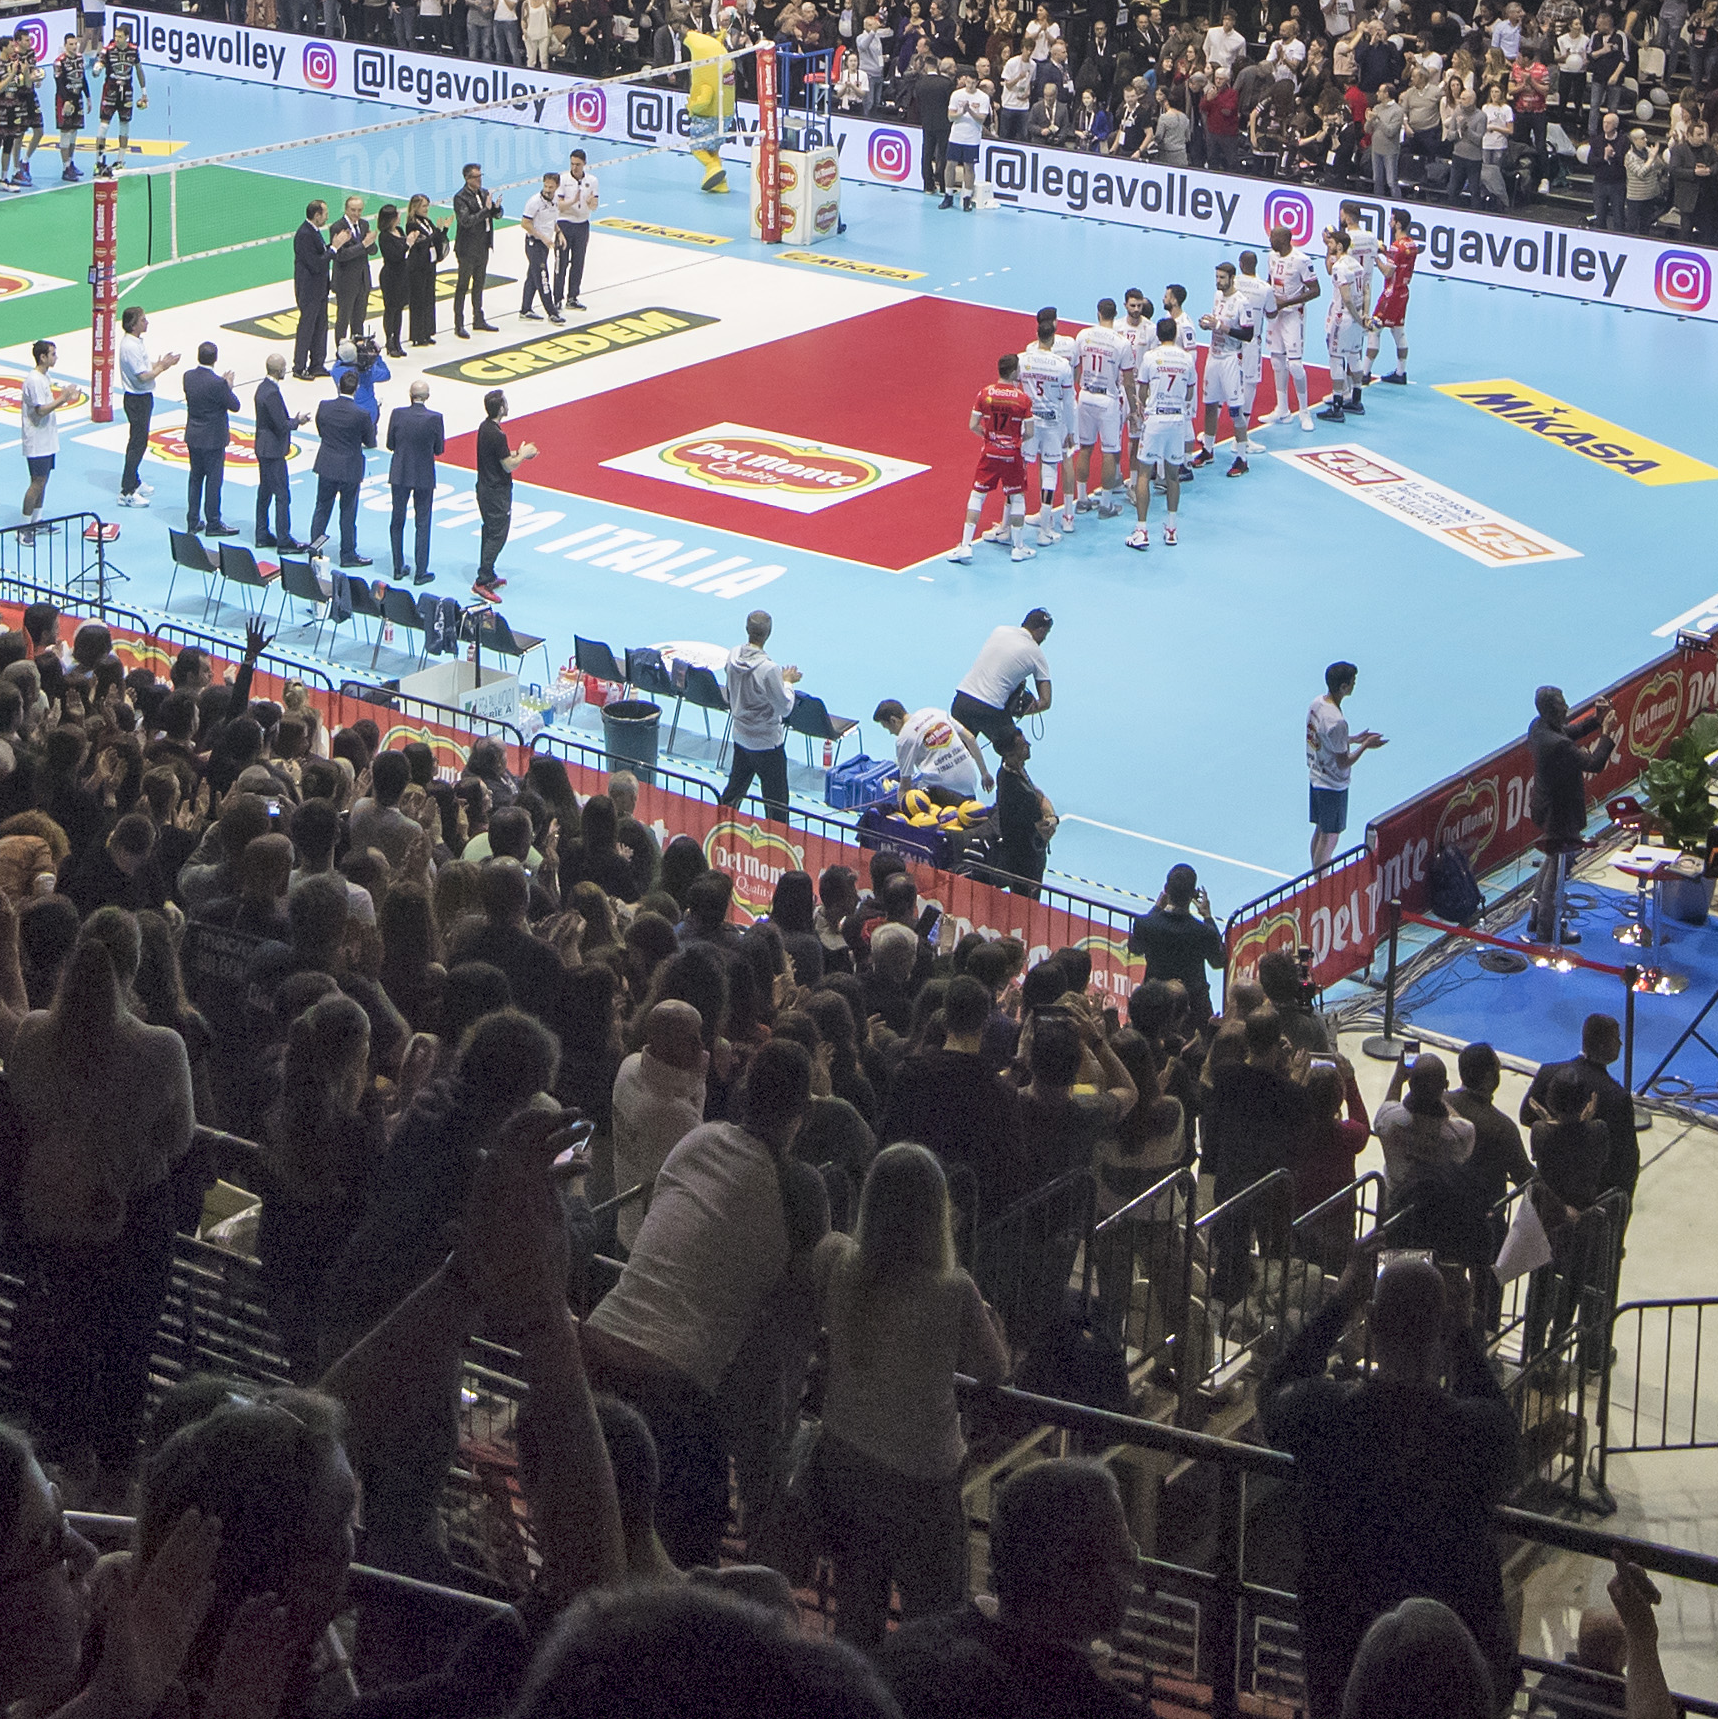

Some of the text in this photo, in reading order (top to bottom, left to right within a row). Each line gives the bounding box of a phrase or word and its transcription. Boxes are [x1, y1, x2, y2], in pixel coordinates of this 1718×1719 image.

[353, 47, 549, 123] @legavolley
[985, 145, 1241, 235] @legavolley
[1276, 263, 1284, 276] 13
[458, 309, 691, 381] CREDEM
[1092, 355, 1103, 372] 11
[1036, 382, 1044, 397] 5
[1168, 374, 1176, 393] 7
[992, 412, 1008, 431] 17
[1455, 392, 1662, 476] MIKASA
[686, 441, 858, 488] Del Monte
[707, 460, 786, 486] Quality
[532, 522, 789, 600] ITALIA
[1462, 805, 1493, 836] Monte
[1505, 774, 1533, 831] De
[716, 845, 742, 871] Del
[1311, 889, 1363, 968] Del
